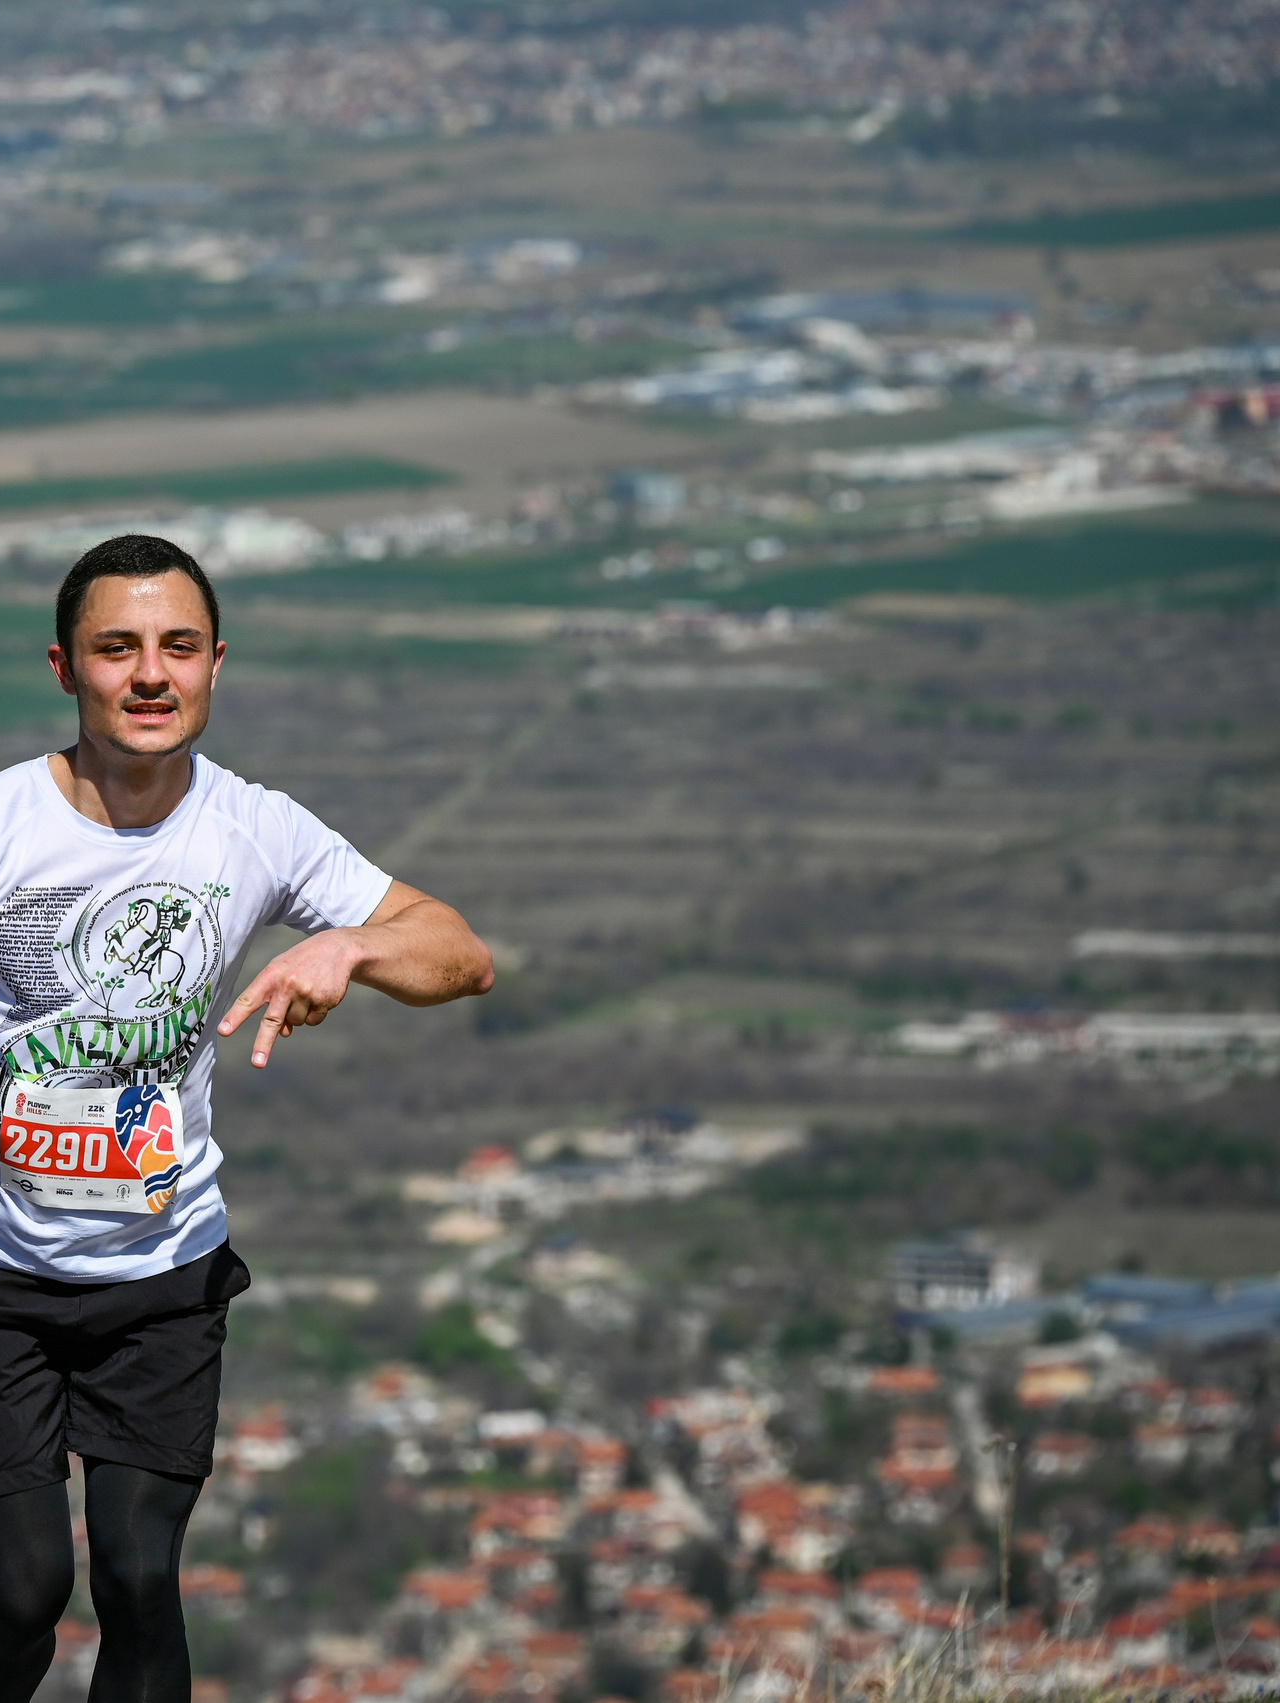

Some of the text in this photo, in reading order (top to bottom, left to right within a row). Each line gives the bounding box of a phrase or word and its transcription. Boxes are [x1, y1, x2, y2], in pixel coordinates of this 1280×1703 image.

[27, 1100, 51, 1110] PLOVDIV
[26, 1107, 42, 1115] HILLS
[4, 1125, 109, 1172] 2290
